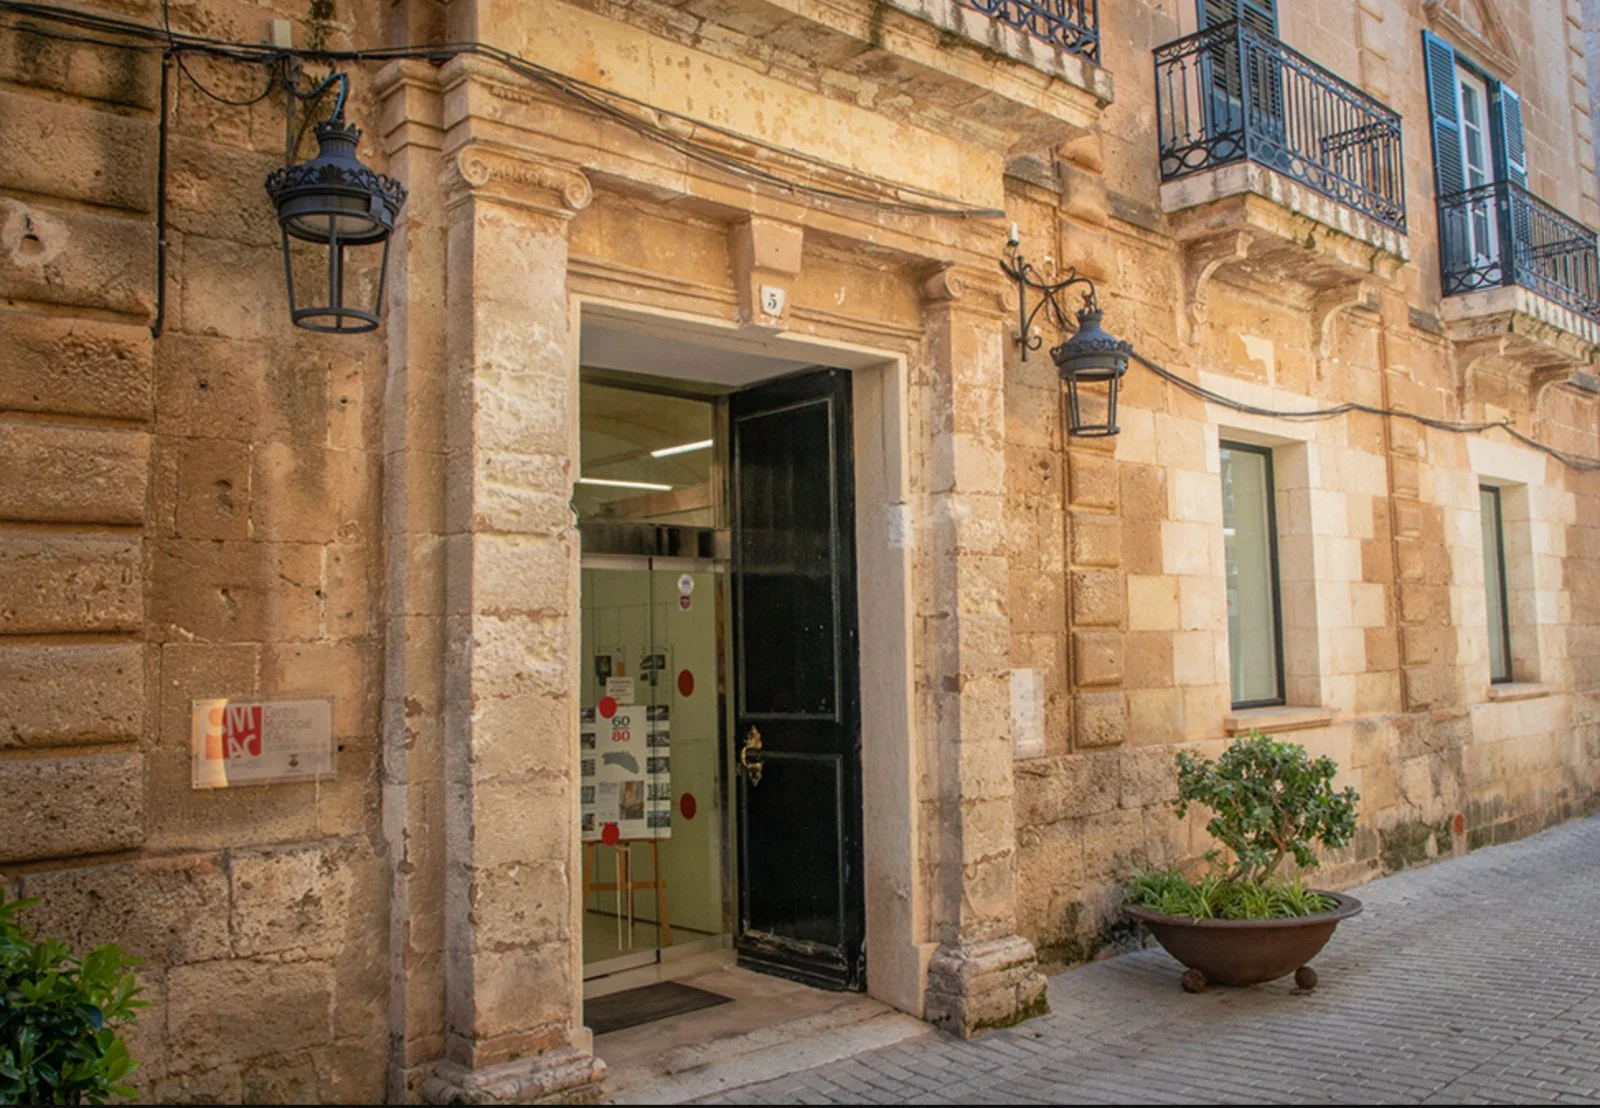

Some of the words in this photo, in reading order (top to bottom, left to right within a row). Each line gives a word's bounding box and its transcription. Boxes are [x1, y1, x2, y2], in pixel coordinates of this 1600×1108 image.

[768, 293, 777, 309] 5
[264, 705, 298, 719] Centre
[612, 715, 631, 727] 60
[612, 730, 631, 742] 80
